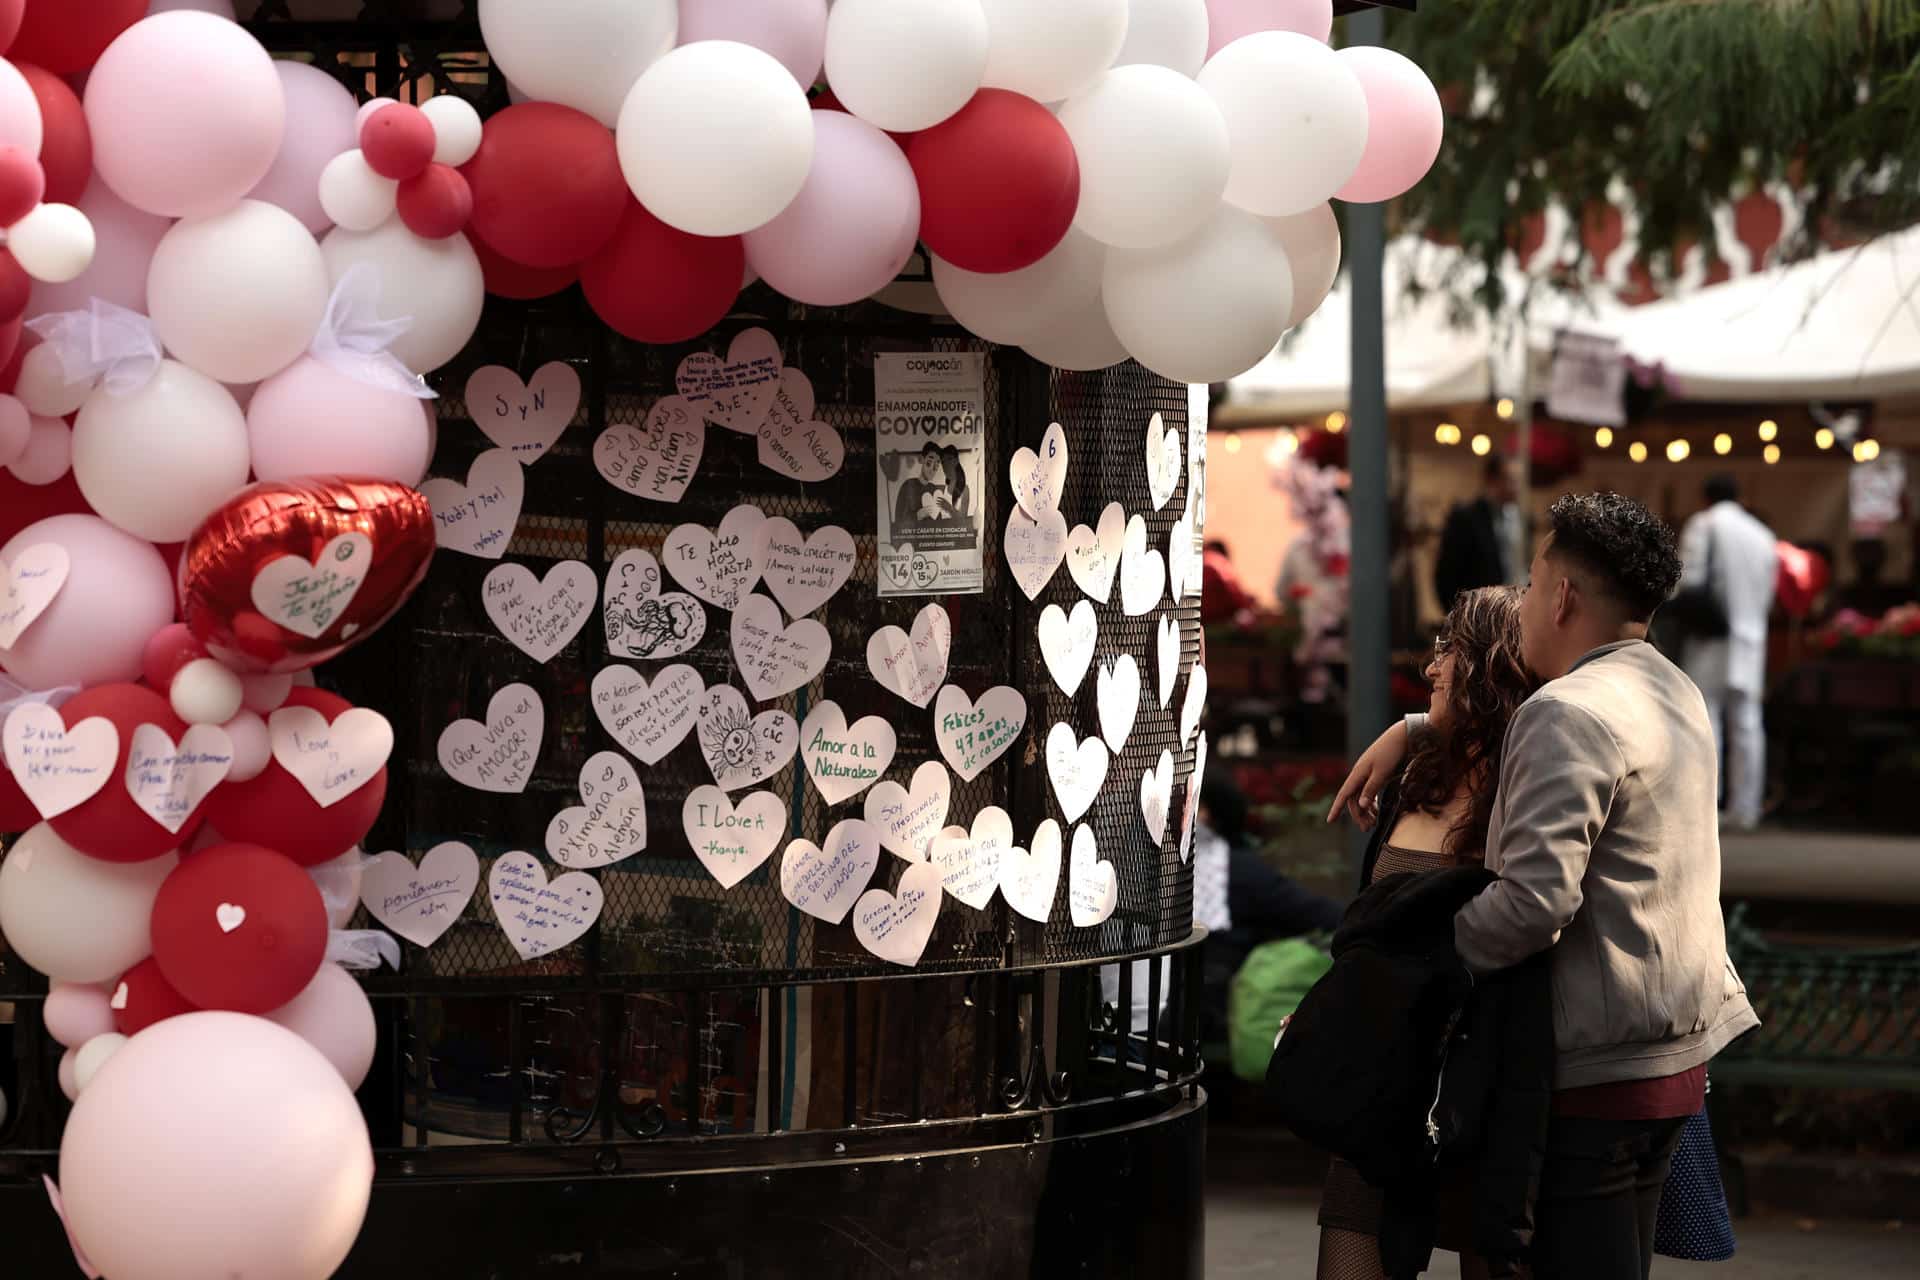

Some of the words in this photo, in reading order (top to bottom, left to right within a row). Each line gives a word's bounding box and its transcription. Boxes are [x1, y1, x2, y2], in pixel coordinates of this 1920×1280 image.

[494, 393, 510, 417] S
[534, 388, 546, 412] N
[877, 398, 967, 412] ENAMORÁNDOTE
[625, 455, 649, 489] amo
[675, 543, 697, 561] TE
[709, 535, 740, 555] AMO
[716, 558, 753, 581] HASTA
[890, 563, 908, 579] 14
[488, 577, 515, 597] Hay
[808, 727, 848, 754] Amor
[850, 743, 860, 757] a
[863, 741, 877, 758] la
[955, 732, 973, 756] 47
[814, 756, 878, 779] Naturaleza
[963, 755, 976, 770] de
[696, 804, 708, 827] I
[714, 804, 752, 828] Love
